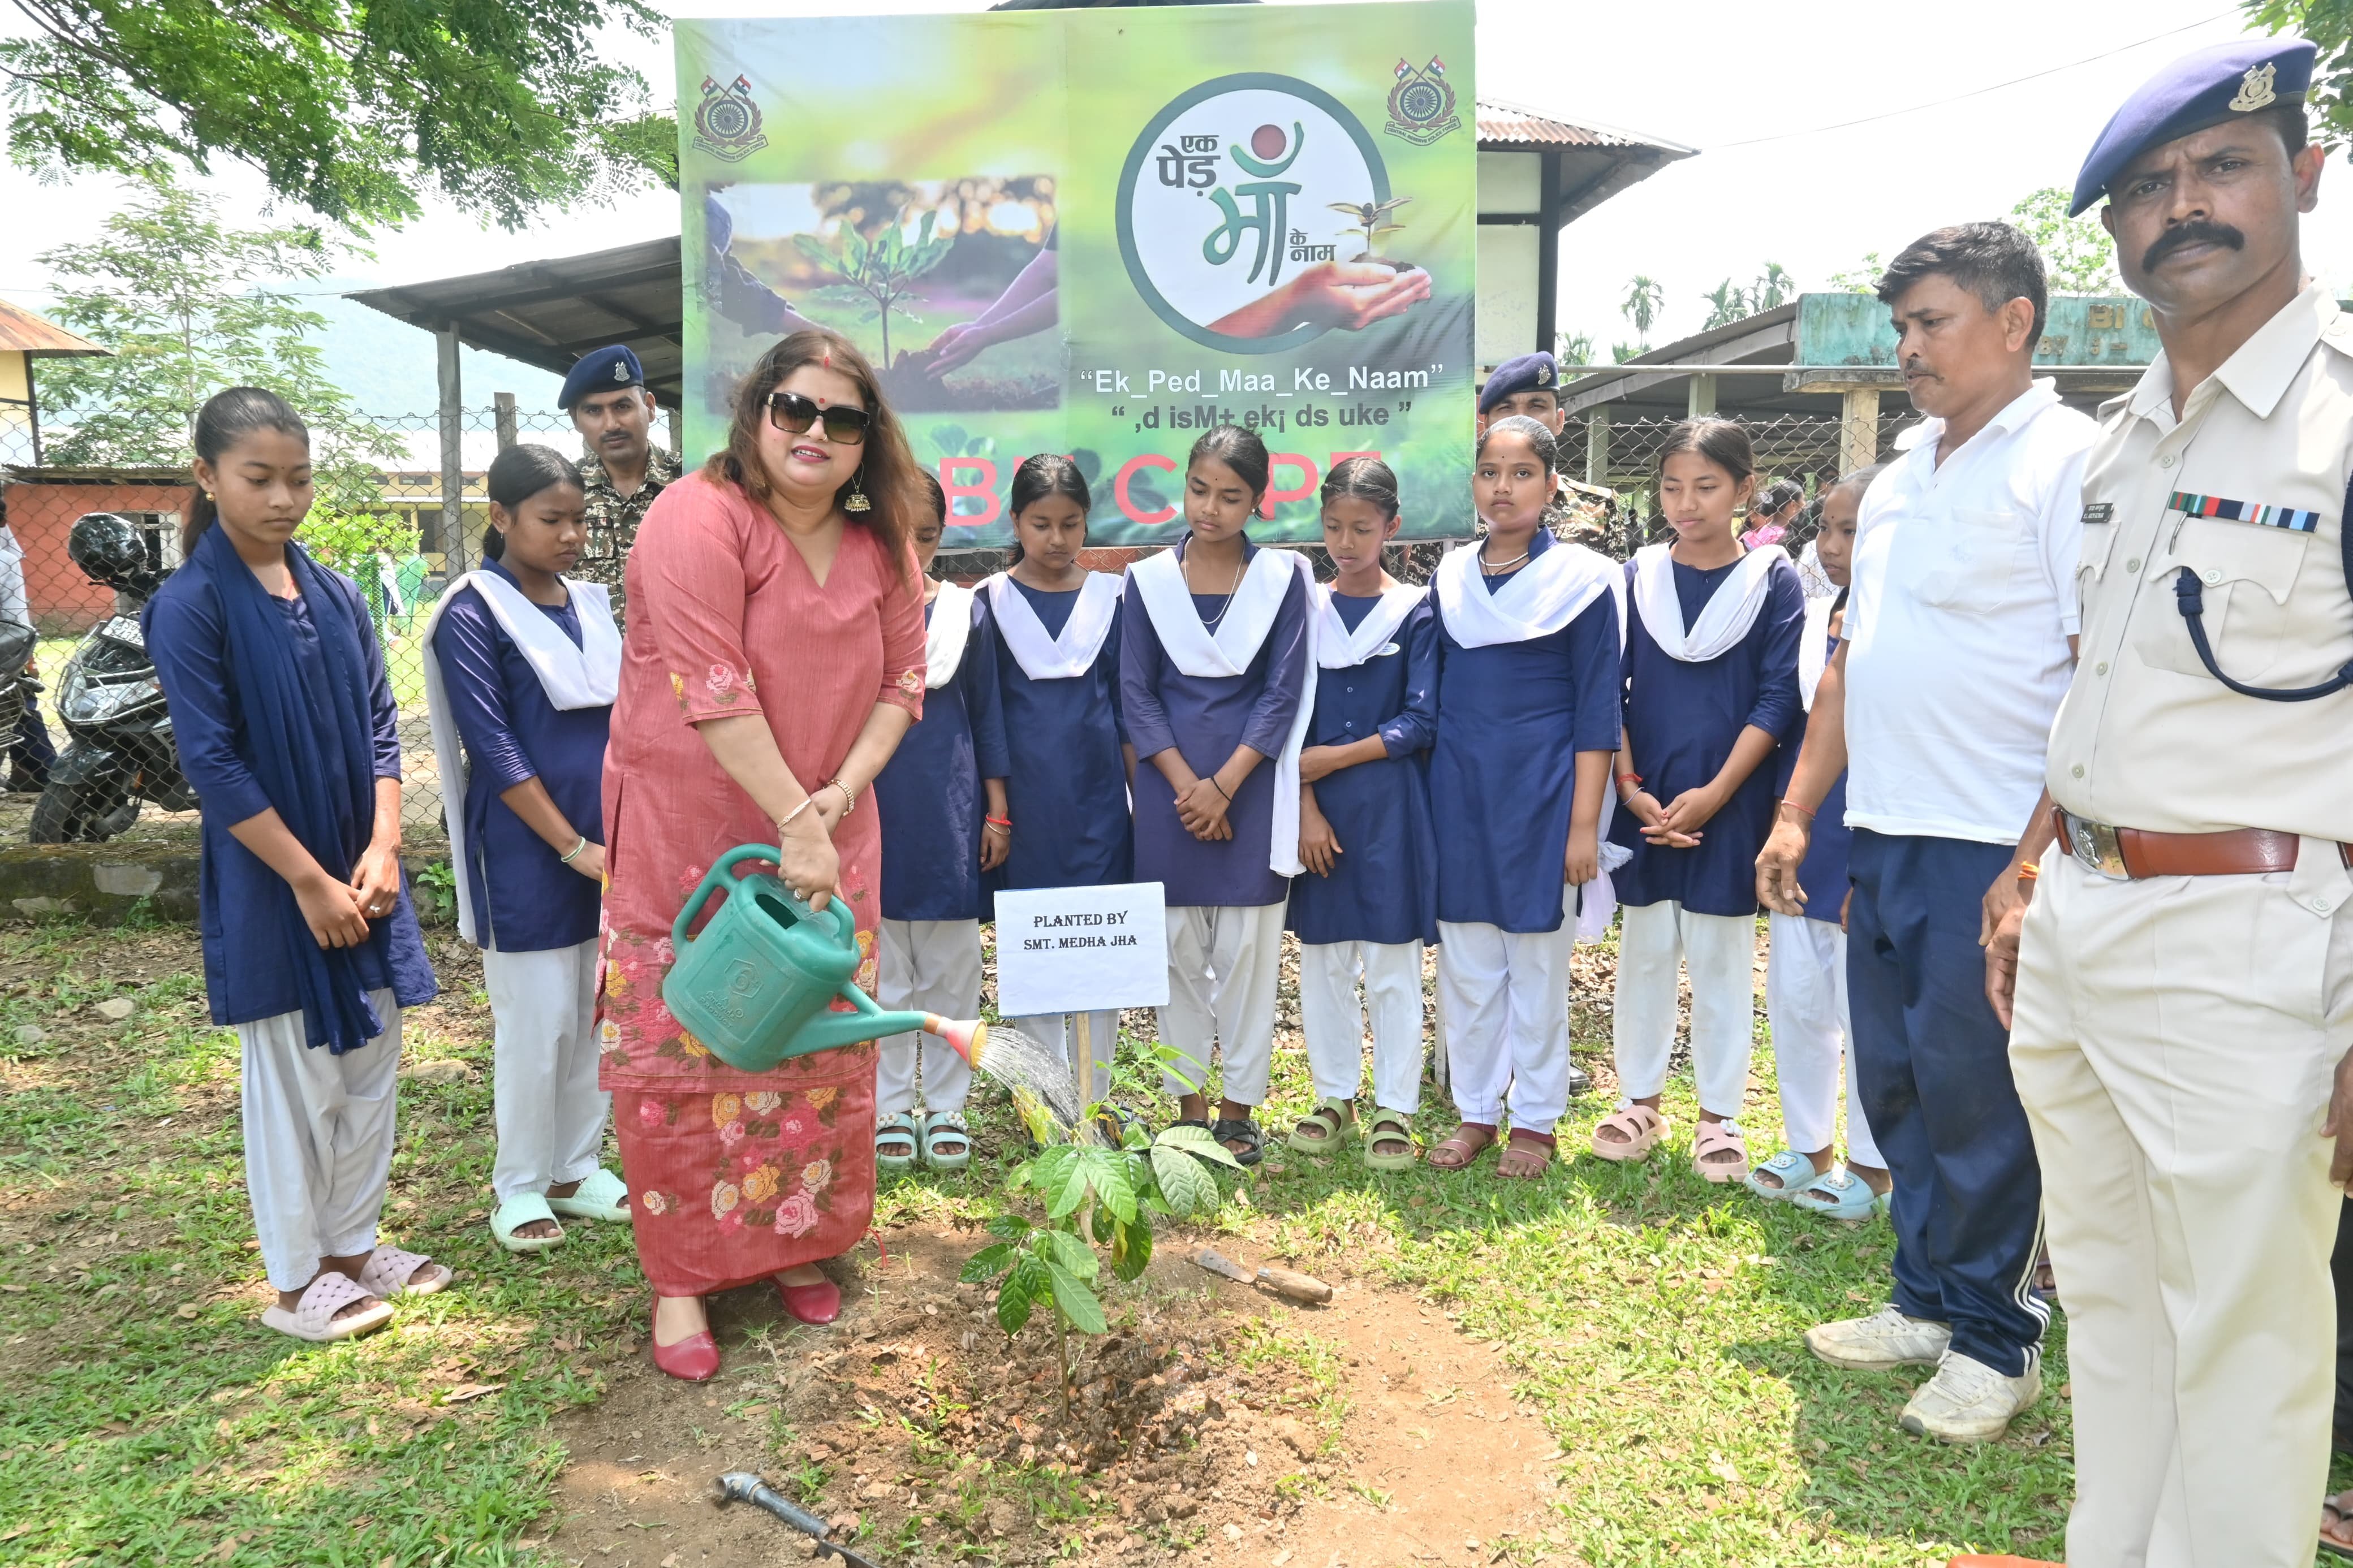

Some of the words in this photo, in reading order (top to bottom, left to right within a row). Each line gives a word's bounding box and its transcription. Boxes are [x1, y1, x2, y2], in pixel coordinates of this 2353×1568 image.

[1387, 127, 1407, 137] CENTRAL
[1428, 131, 1442, 142] POLICE
[1442, 123, 1457, 133] FORCE
[1180, 135, 1219, 153] एक
[1156, 145, 1221, 197] पेड़
[1290, 228, 1308, 245] के
[1290, 245, 1337, 262] नाम
[1296, 404, 1329, 427] ds
[1033, 914, 1102, 928] PLANTED
[1107, 910, 1128, 925] BY
[1023, 939, 1055, 950] SMT.
[1059, 936, 1106, 948] MEDHA
[1110, 935, 1137, 947] JHA
